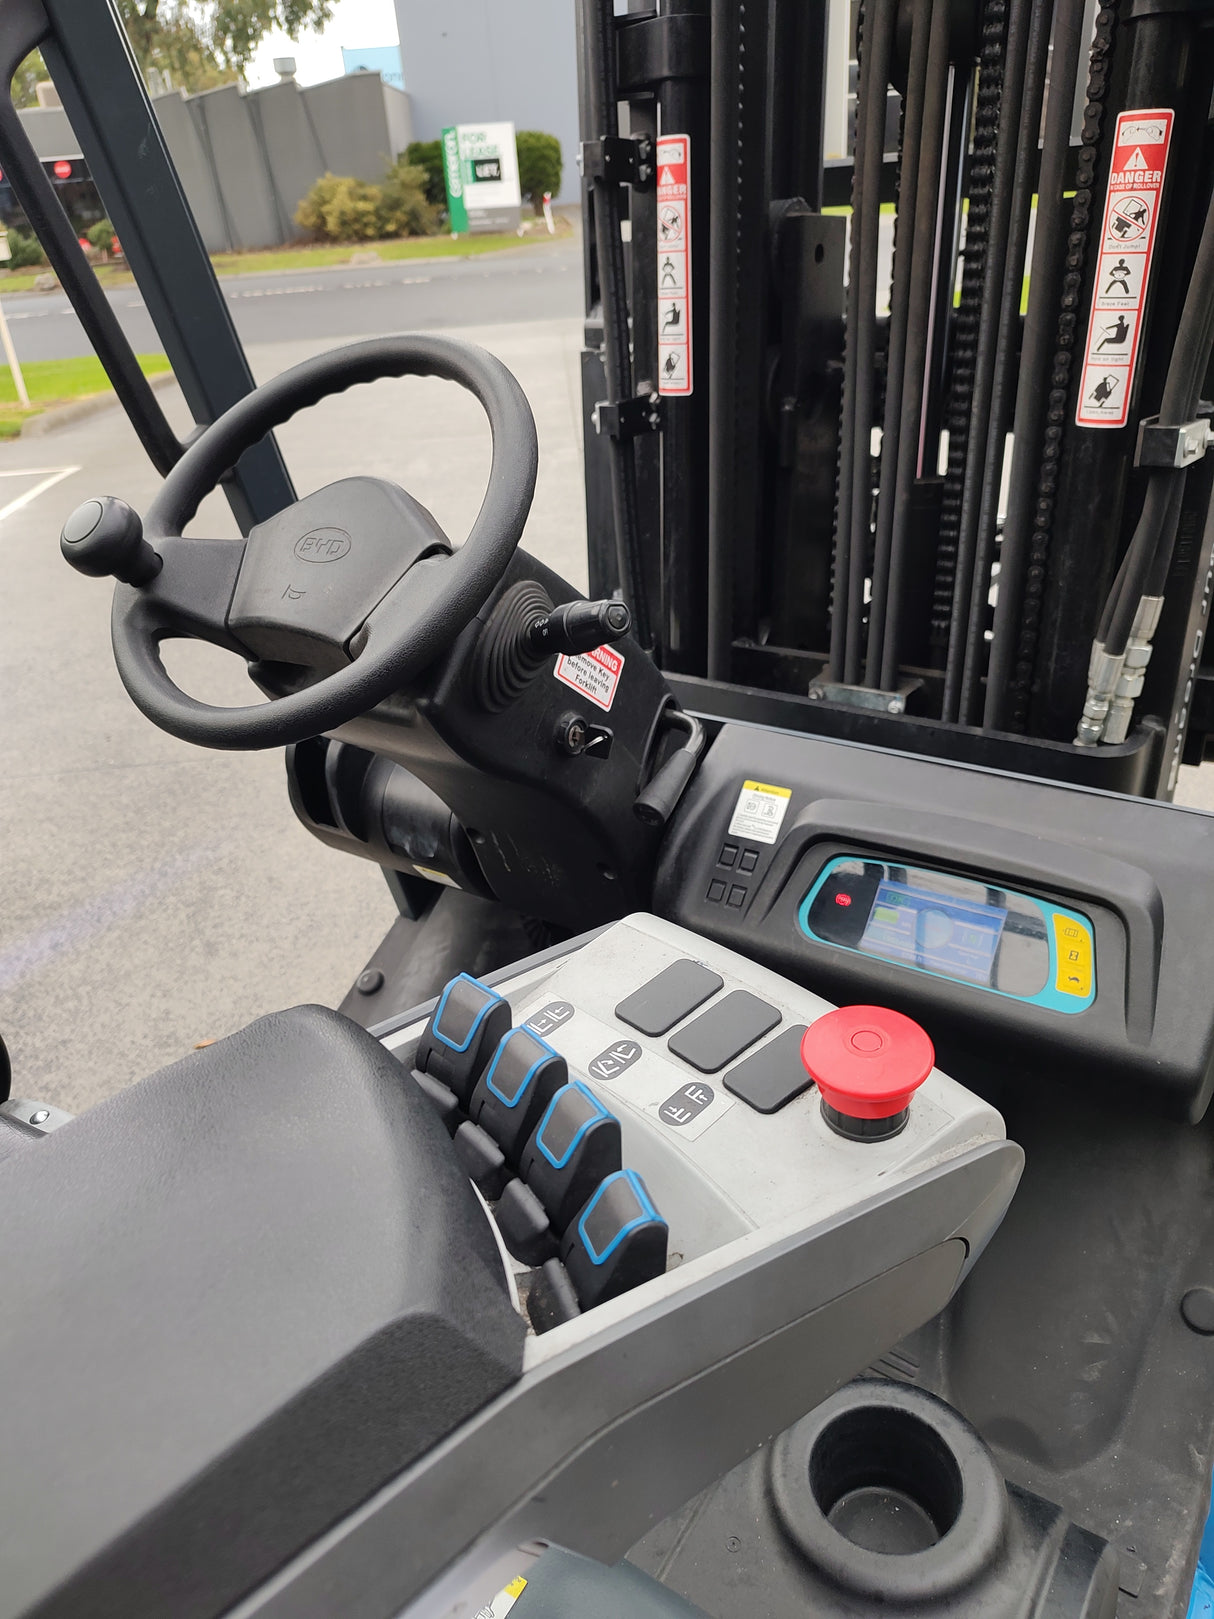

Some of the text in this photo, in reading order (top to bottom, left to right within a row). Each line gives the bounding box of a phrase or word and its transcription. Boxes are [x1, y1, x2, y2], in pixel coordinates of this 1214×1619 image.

[1110, 171, 1162, 184] DANGER
[300, 537, 343, 554] BYD
[591, 648, 619, 672] RNING
[567, 656, 610, 693] before leaving
[598, 666, 610, 682] Key
[575, 674, 598, 694] Forklift
